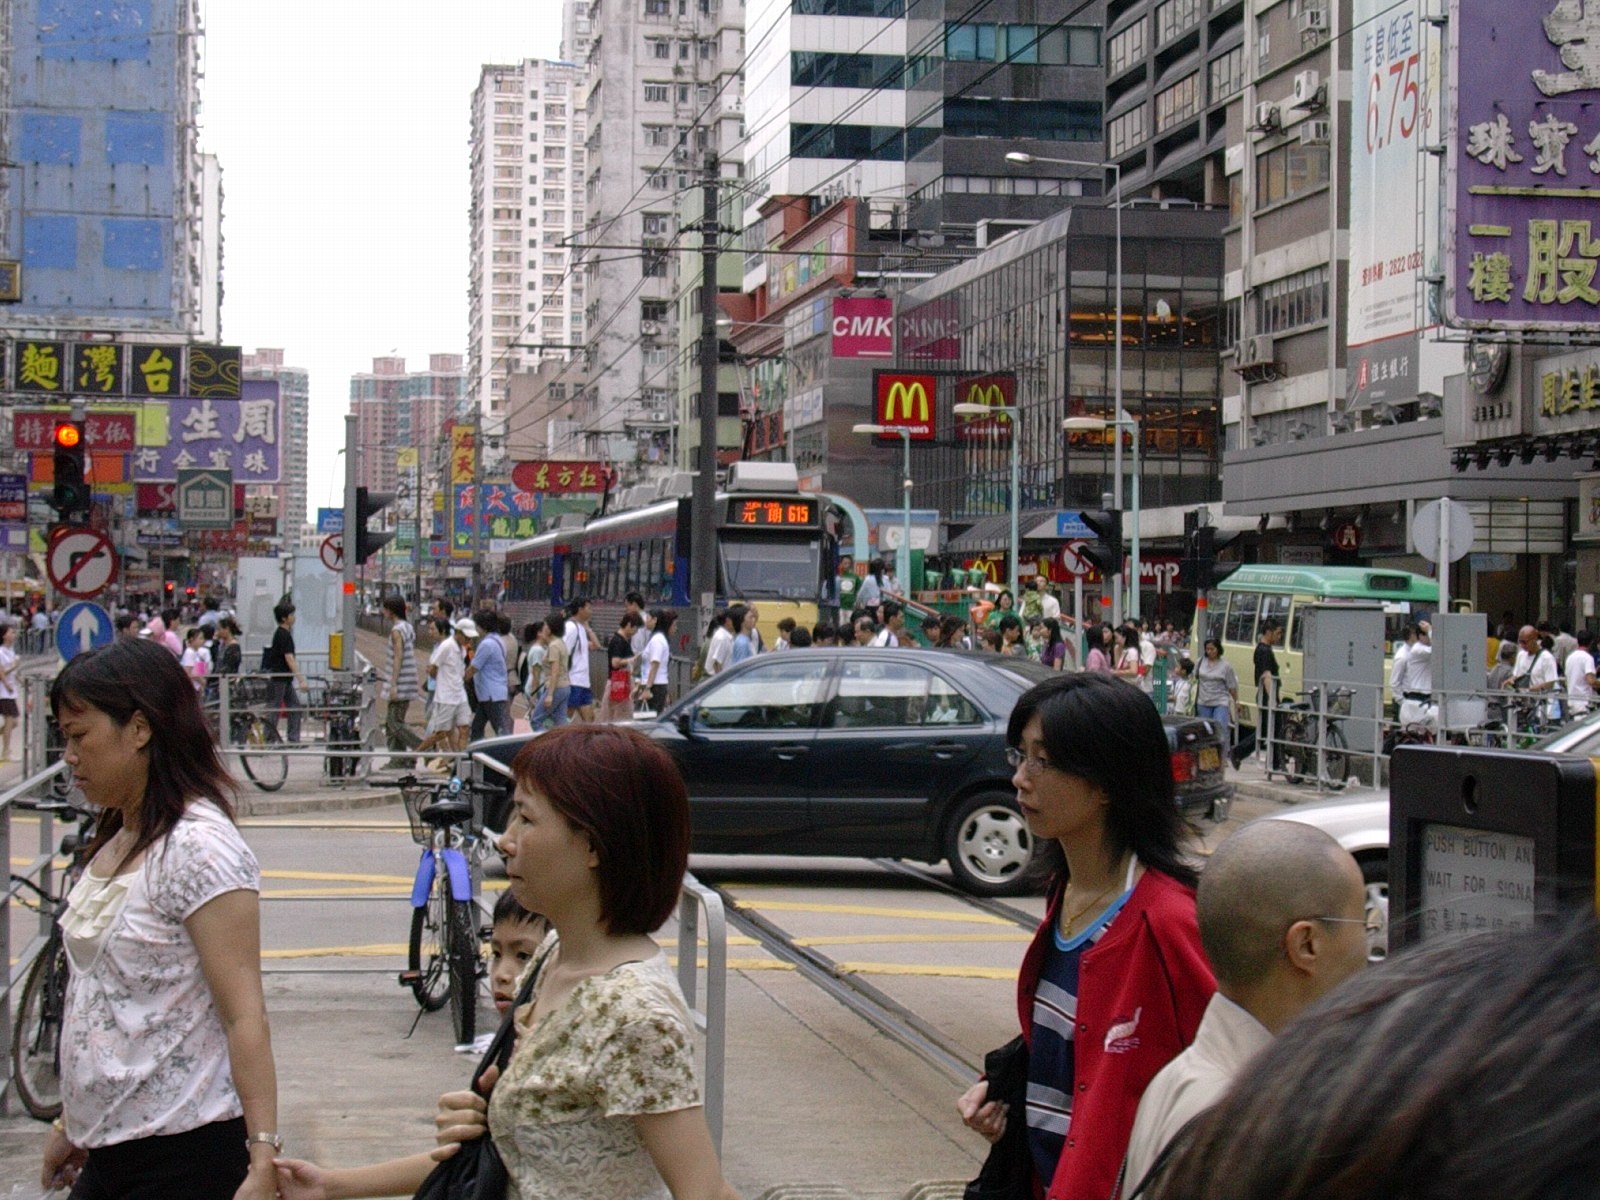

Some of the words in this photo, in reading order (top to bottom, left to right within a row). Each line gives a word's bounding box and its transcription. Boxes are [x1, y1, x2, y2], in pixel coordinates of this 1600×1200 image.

[833, 316, 893, 337] CMK
[788, 505, 809, 522] 615
[1463, 839, 1507, 861] BUTTON
[1515, 846, 1534, 865] AN
[1427, 871, 1452, 889] WAIT
[1463, 875, 1486, 894] FOR
